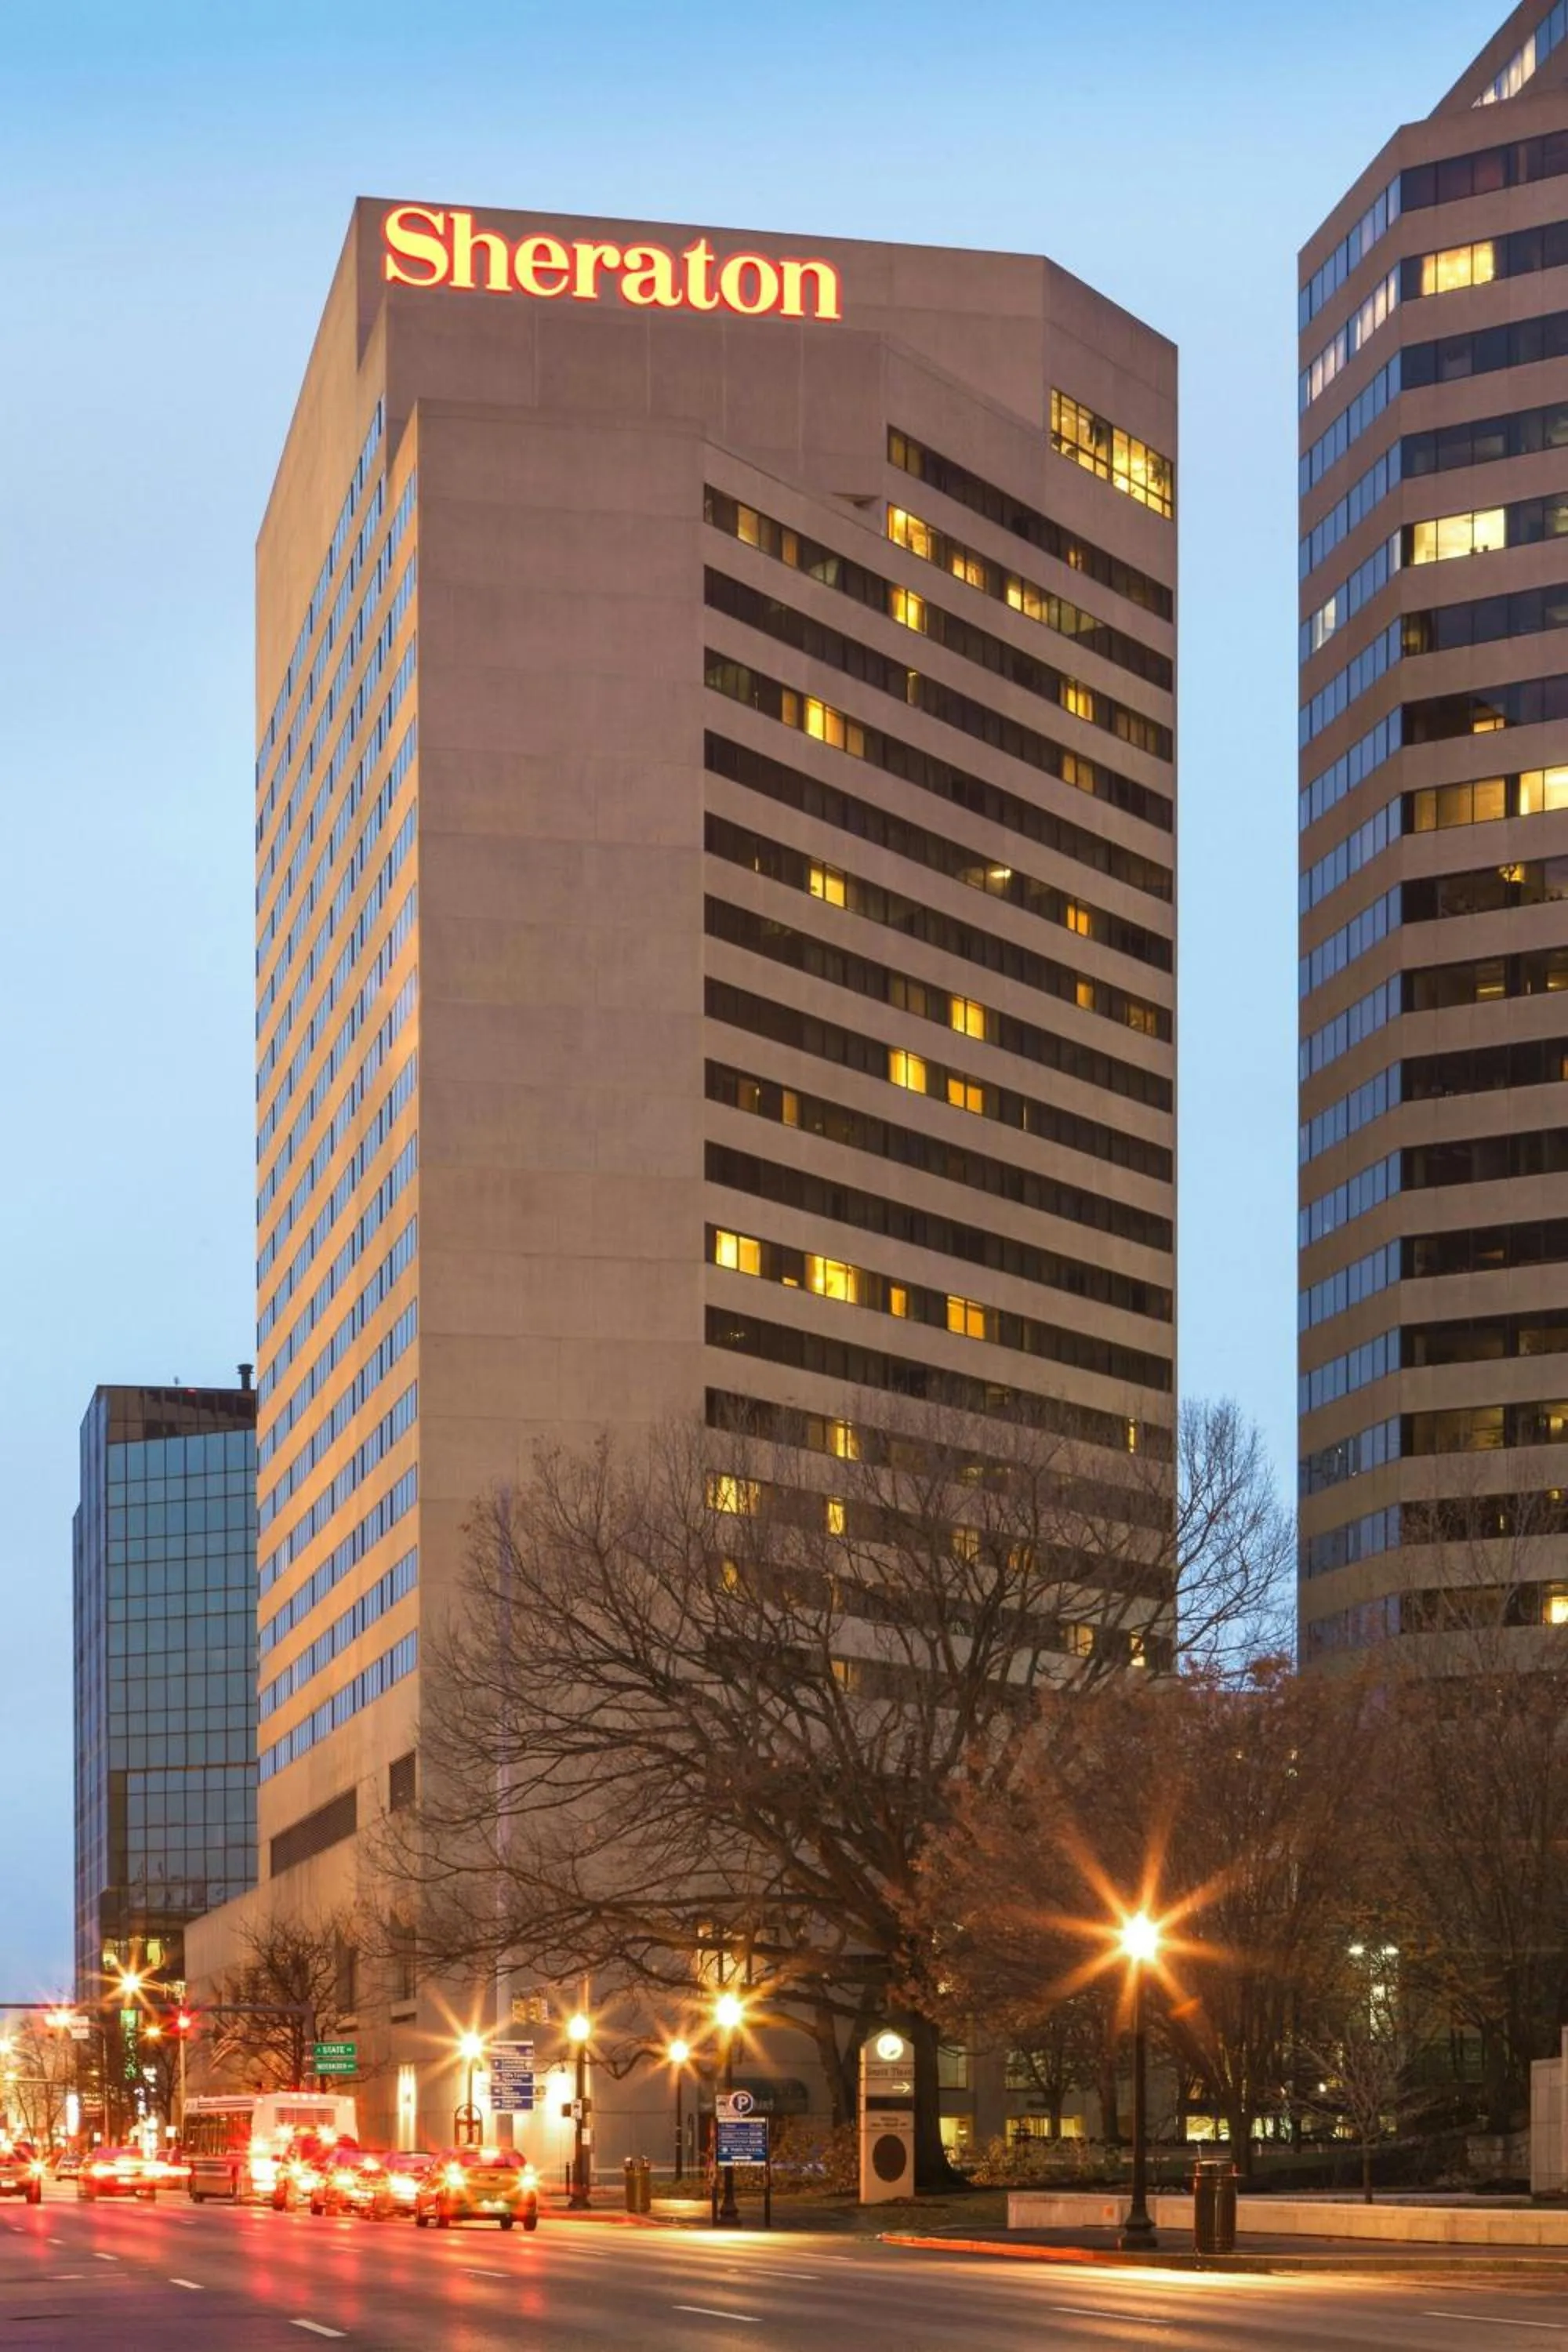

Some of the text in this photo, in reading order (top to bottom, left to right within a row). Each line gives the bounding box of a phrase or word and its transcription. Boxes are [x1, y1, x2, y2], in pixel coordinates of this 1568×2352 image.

[383, 205, 841, 321] Sheraton
[322, 2045, 345, 2054] STATE
[738, 2096, 749, 2110] P
